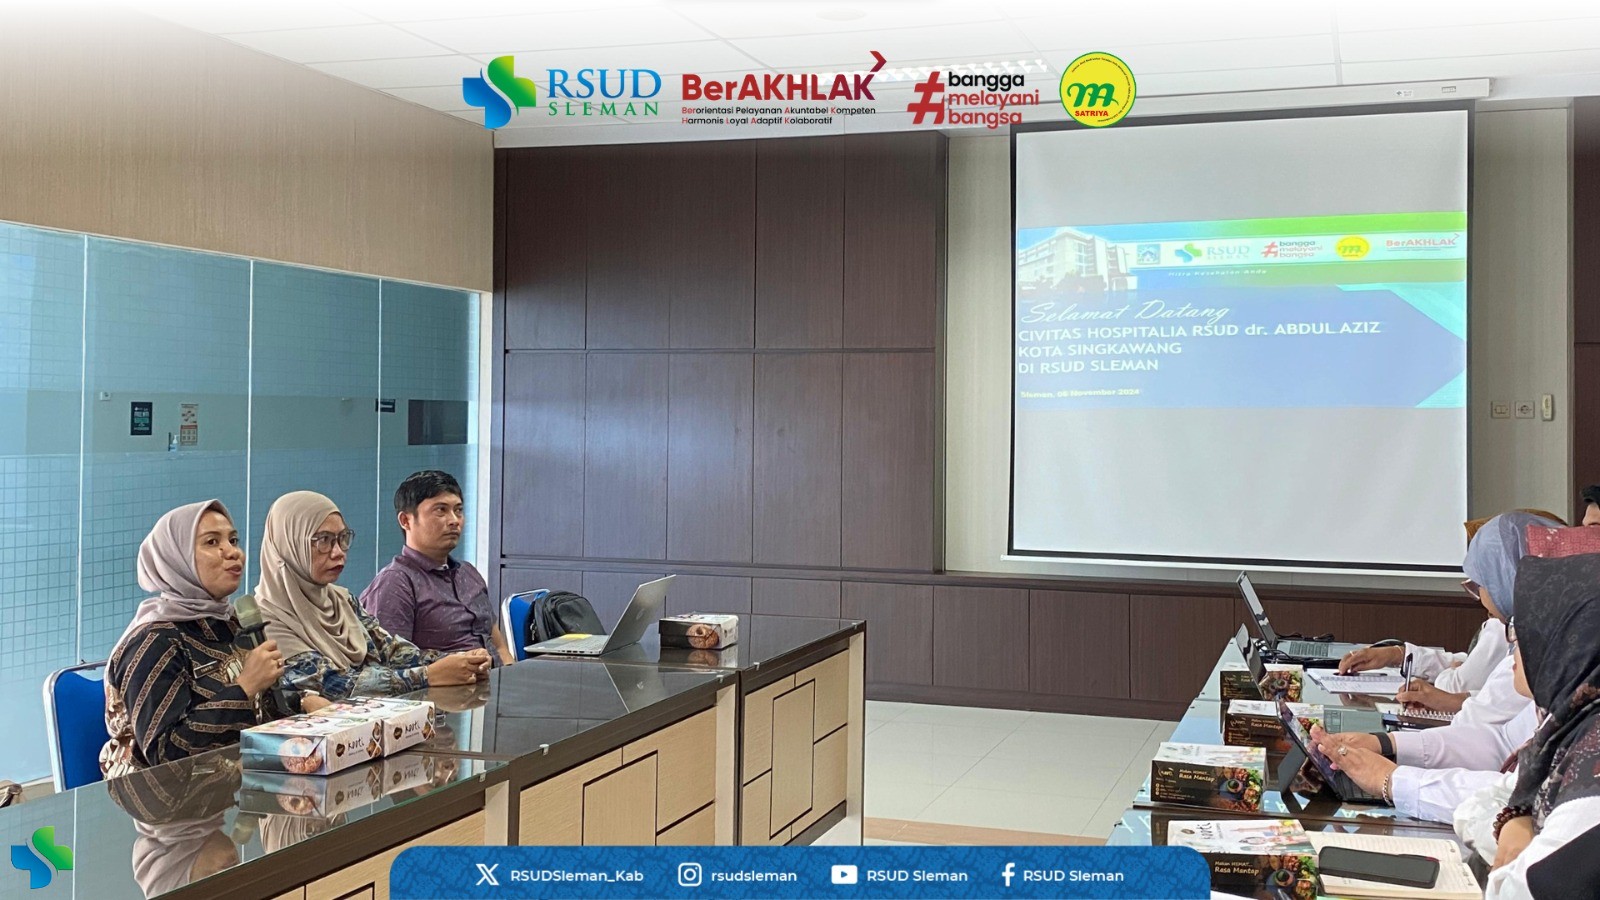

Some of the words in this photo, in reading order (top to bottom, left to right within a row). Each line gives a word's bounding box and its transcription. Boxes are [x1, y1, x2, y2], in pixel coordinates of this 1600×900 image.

[1386, 238, 1456, 247] BerAKHLAK
[1206, 245, 1250, 256] RSUD
[1279, 251, 1315, 259] bangsa
[1021, 302, 1130, 324] Selamat
[1135, 299, 1230, 325] Datang
[1018, 327, 1082, 342] CIVITAS
[1087, 325, 1187, 339] HOSPITALIA
[1192, 324, 1239, 337] RSUD
[1244, 323, 1268, 336] dr.
[1274, 322, 1339, 335] ABDUL
[1340, 320, 1381, 334] AZIZ
[1018, 344, 1063, 358] KOTA
[1067, 341, 1182, 356] SINGKAWANG
[1018, 361, 1034, 374] DI
[1040, 360, 1085, 373] RSUD
[1090, 358, 1159, 372] SLEMAN
[1070, 389, 1116, 397] November
[1117, 388, 1140, 396] 2024
[1178, 772, 1192, 780] Rasa
[1193, 774, 1216, 783] Mantap
[1214, 866, 1231, 874] Rasa
[1232, 867, 1260, 876] Mantap
